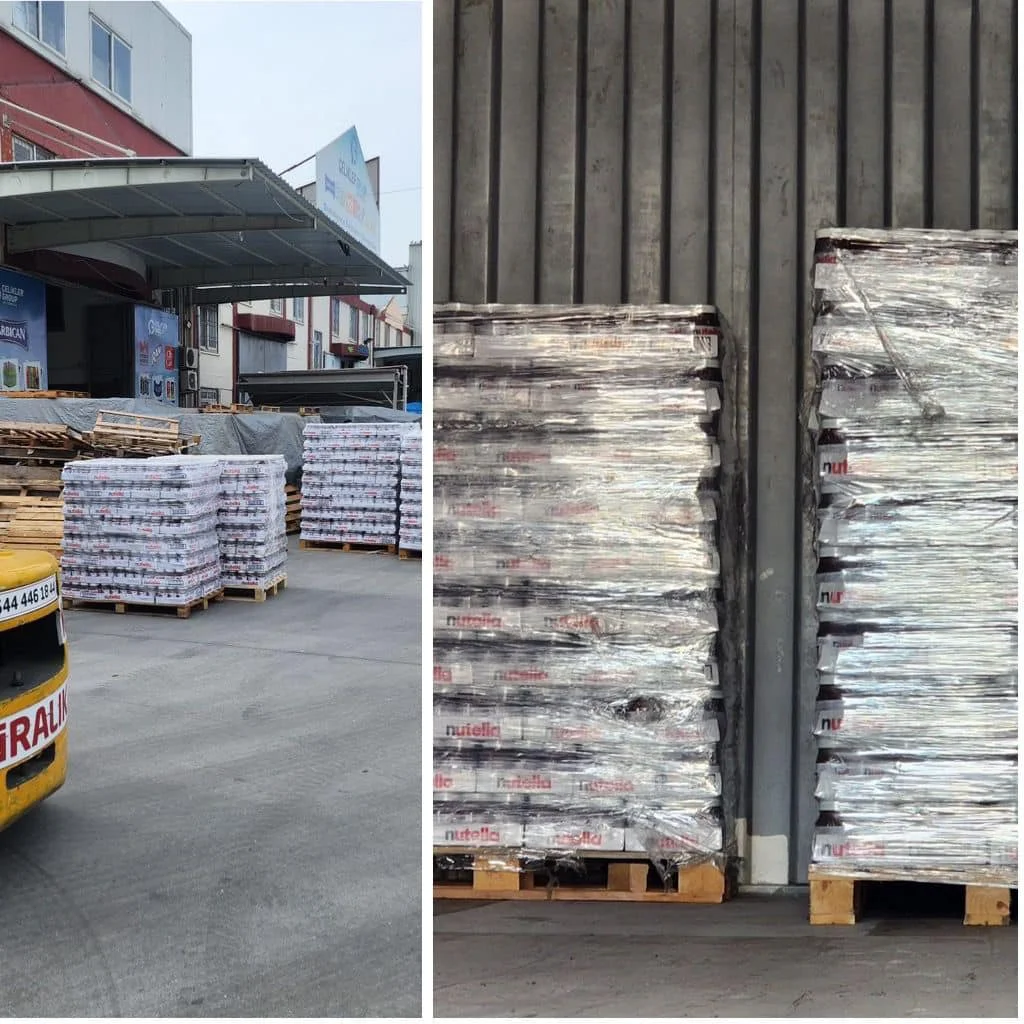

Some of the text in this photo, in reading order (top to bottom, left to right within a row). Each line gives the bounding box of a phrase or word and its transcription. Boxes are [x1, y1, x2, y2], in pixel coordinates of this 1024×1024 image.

[21, 588, 38, 607] 446
[40, 584, 49, 600] 18
[446, 722, 500, 737] nutella
[445, 828, 500, 842] nutella
